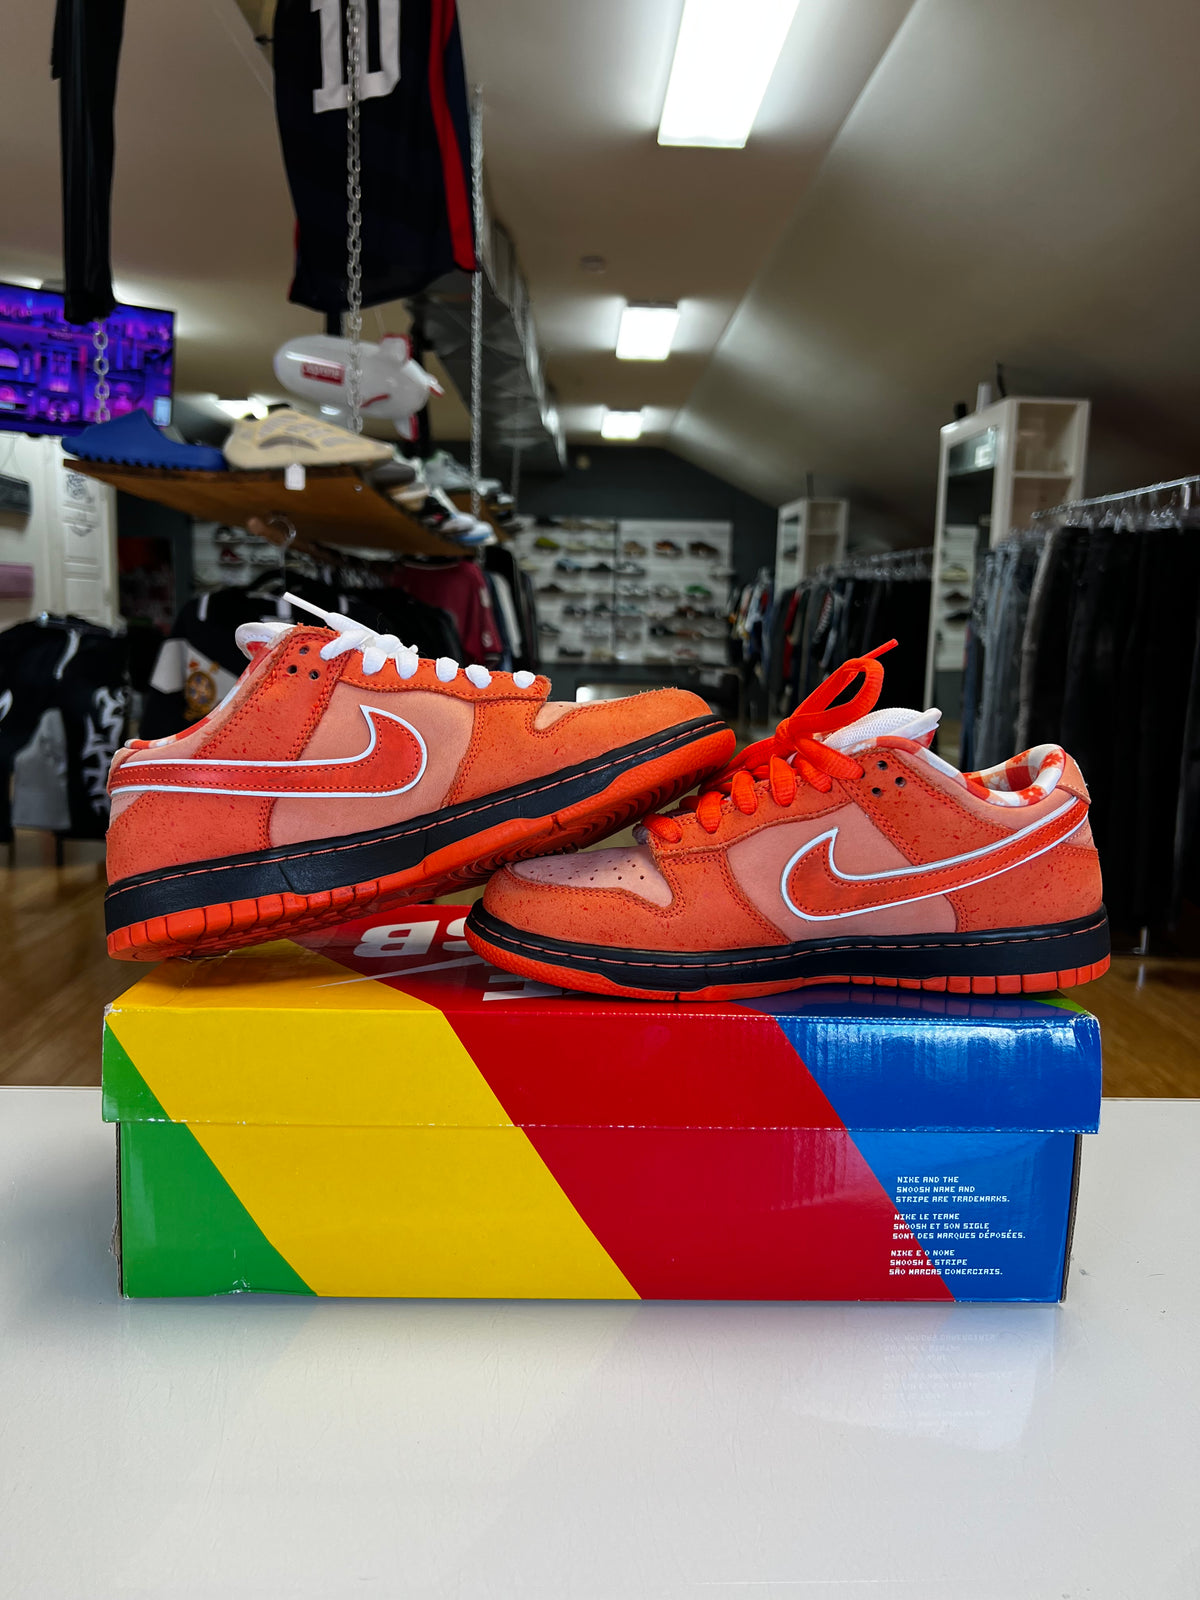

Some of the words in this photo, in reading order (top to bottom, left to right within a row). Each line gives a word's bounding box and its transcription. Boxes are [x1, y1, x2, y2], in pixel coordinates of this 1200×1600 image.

[896, 1176, 920, 1184] NIKE
[922, 1176, 940, 1184] AND
[942, 1176, 960, 1184] THE
[896, 1186, 931, 1194] SWOOSH
[932, 1185, 956, 1193] NAME
[958, 1185, 976, 1193] AND
[895, 1195, 930, 1203] STRIPE
[931, 1195, 949, 1203] ARE
[951, 1195, 1010, 1203] TRADEMARKS.
[894, 1213, 917, 1221] NIKE
[919, 1213, 930, 1221] LE
[929, 1222, 941, 1230] ET
[943, 1222, 961, 1230] SON
[962, 1222, 990, 1230] SIGLE
[892, 1232, 915, 1240] SONT
[917, 1232, 935, 1240] DES
[936, 1232, 976, 1240] MARQUES
[978, 1229, 1027, 1239] DÉPOSÉES.
[890, 1249, 913, 1257] NIKE
[916, 1249, 922, 1257] E
[932, 1249, 955, 1257] NOME
[934, 1258, 968, 1266] STRIPE
